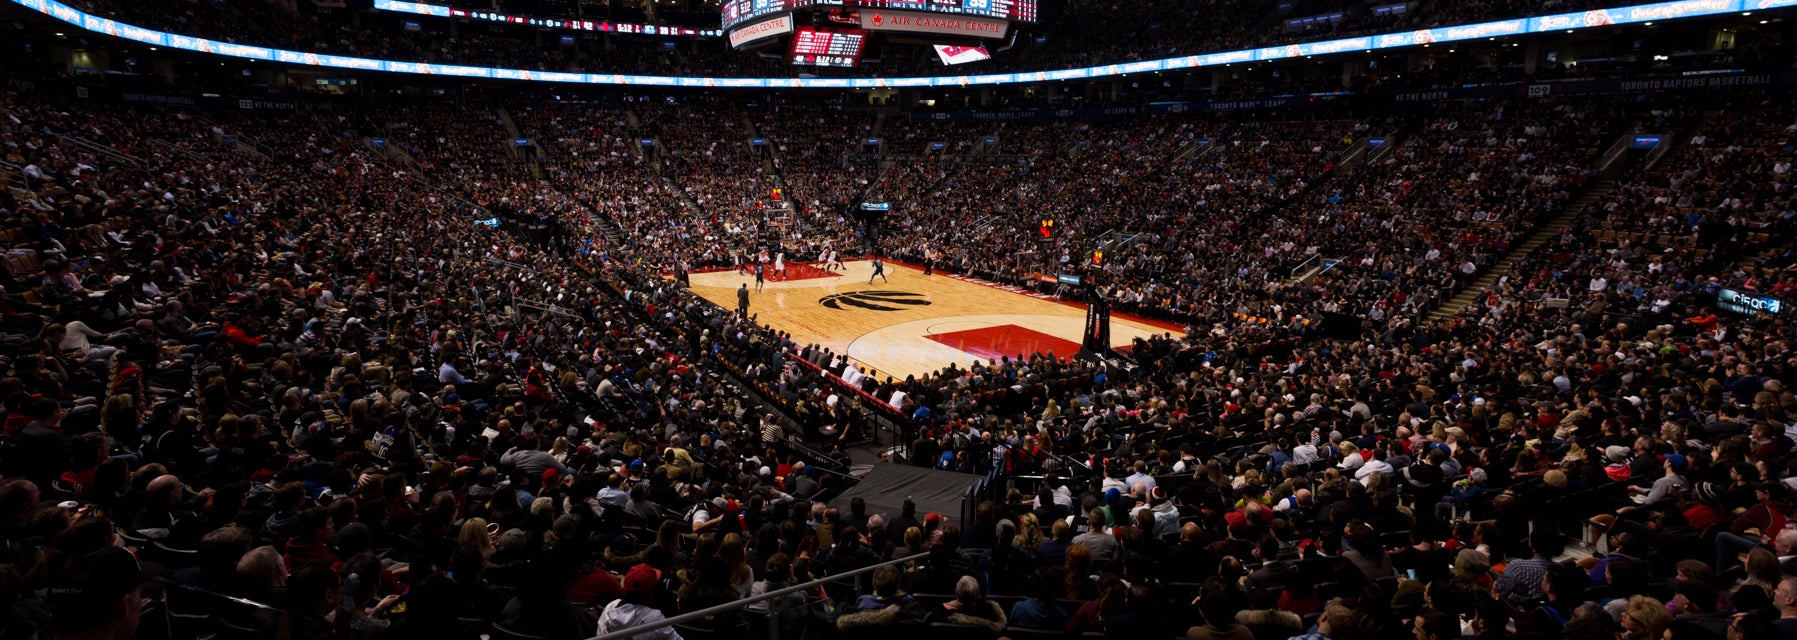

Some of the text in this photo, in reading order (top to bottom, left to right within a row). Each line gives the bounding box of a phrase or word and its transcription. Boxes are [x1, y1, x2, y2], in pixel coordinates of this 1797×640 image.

[741, 26, 759, 38] CANADA
[760, 19, 784, 32] CENTRE
[890, 16, 1001, 33] AIR CANADA CENTRE
[1530, 87, 1549, 95] 109
[1620, 75, 1772, 91] TORONTO RAPTORS BASKETBALL
[1406, 93, 1420, 101] THE
[1422, 91, 1448, 100] NORTH
[1210, 102, 1237, 110] TORONTO
[1732, 294, 1768, 310] cisco
